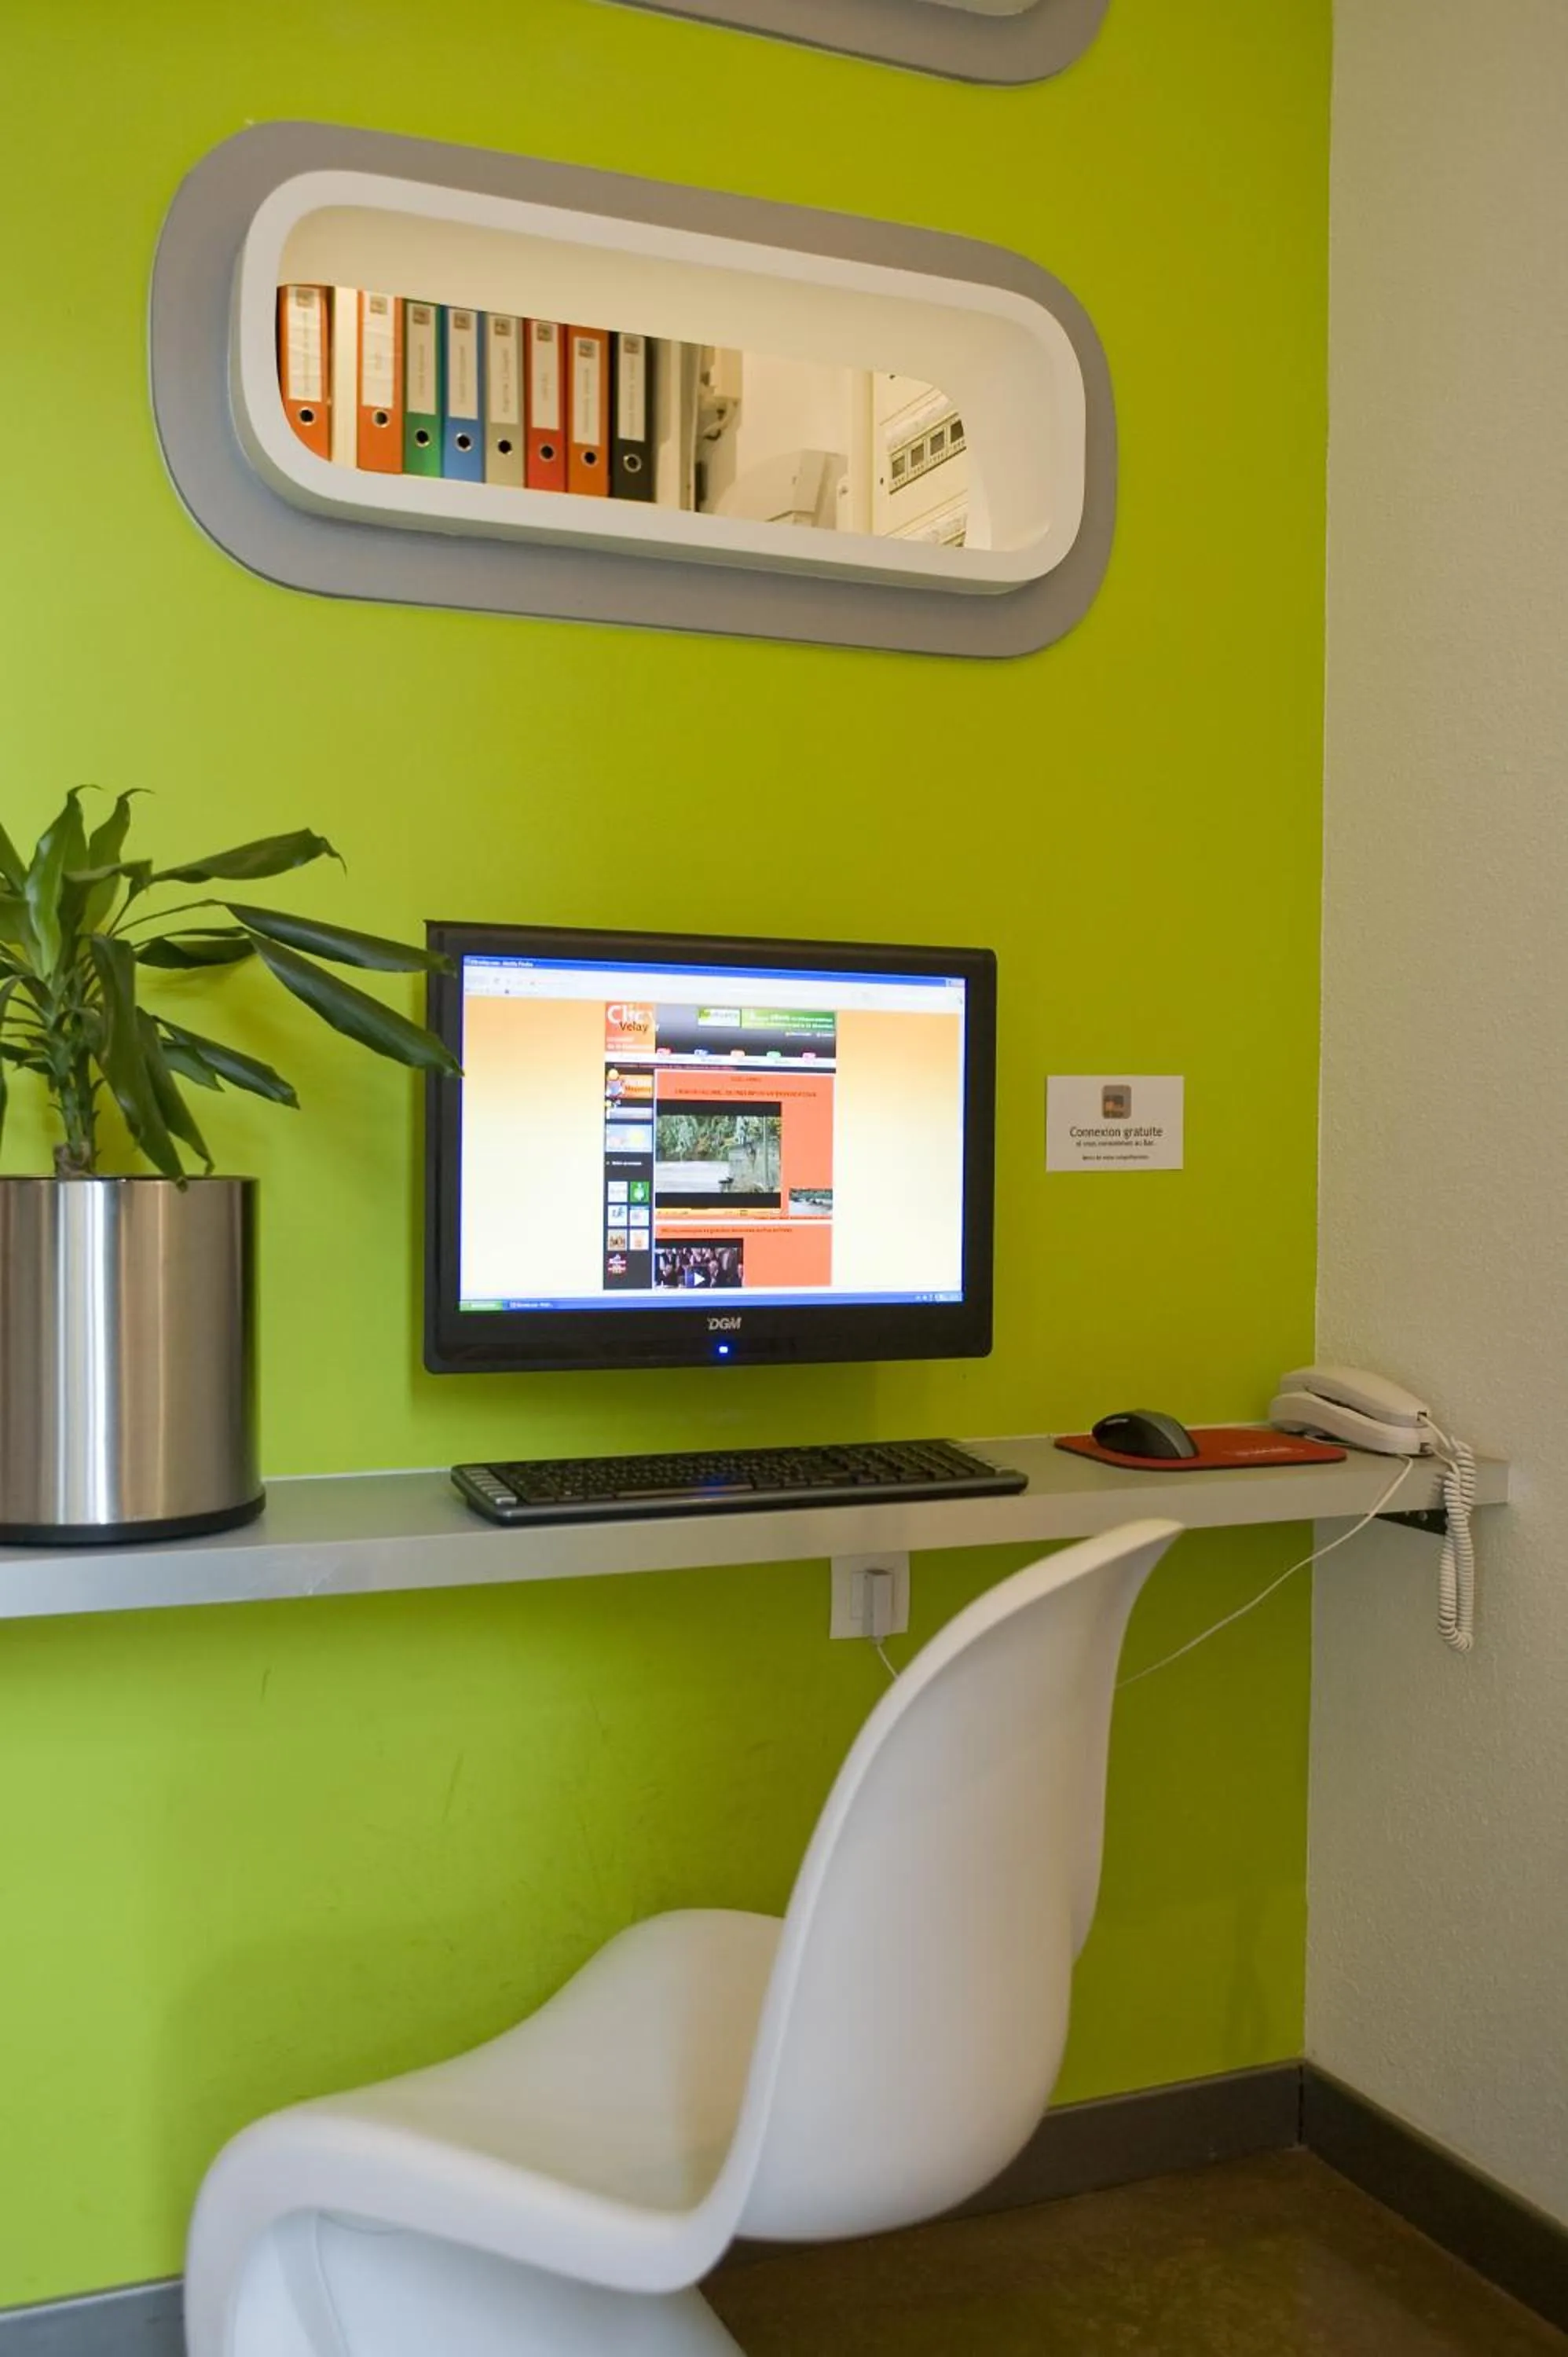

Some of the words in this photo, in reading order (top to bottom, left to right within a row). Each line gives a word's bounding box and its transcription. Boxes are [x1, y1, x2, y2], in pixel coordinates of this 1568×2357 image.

[619, 1021, 649, 1035] Velay
[1069, 1126, 1121, 1138] Connexion
[1123, 1126, 1163, 1139] gratuite
[707, 1317, 742, 1330] DGM
